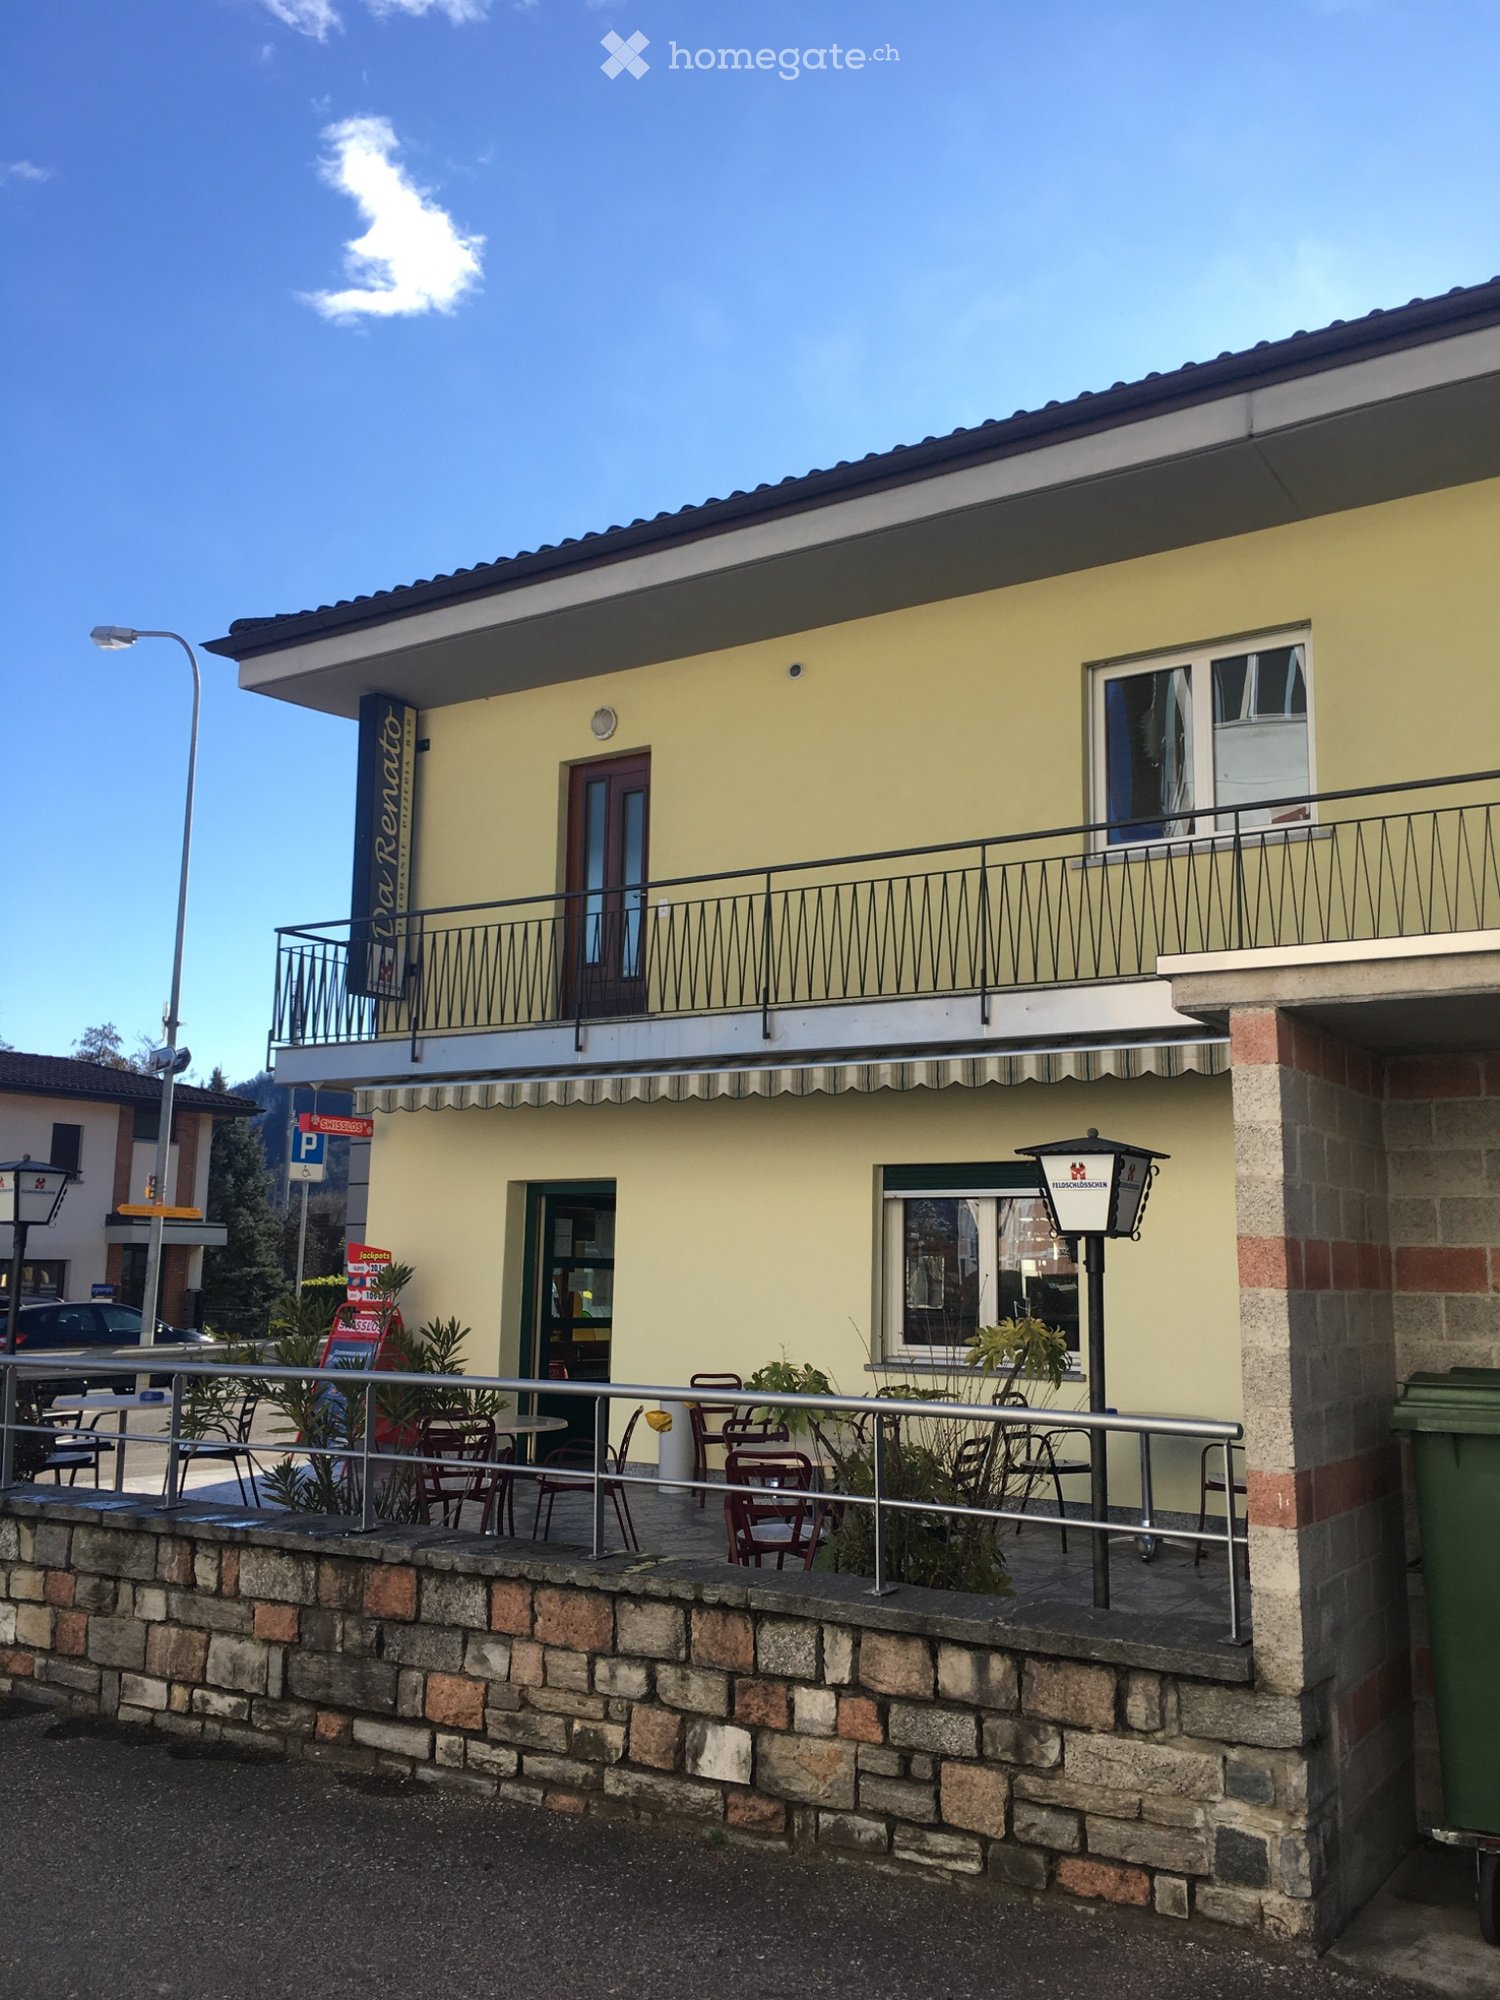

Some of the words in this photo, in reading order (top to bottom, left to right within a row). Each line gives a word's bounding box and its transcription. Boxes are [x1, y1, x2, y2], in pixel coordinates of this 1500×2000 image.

[405, 718, 413, 747] BAR
[374, 704, 402, 867] Renato
[371, 869, 395, 941] Da
[319, 1118, 363, 1133] SWISSLOS
[300, 1132, 318, 1160] P
[1052, 1180, 1108, 1189] FELDSCHLÖSSCHEN
